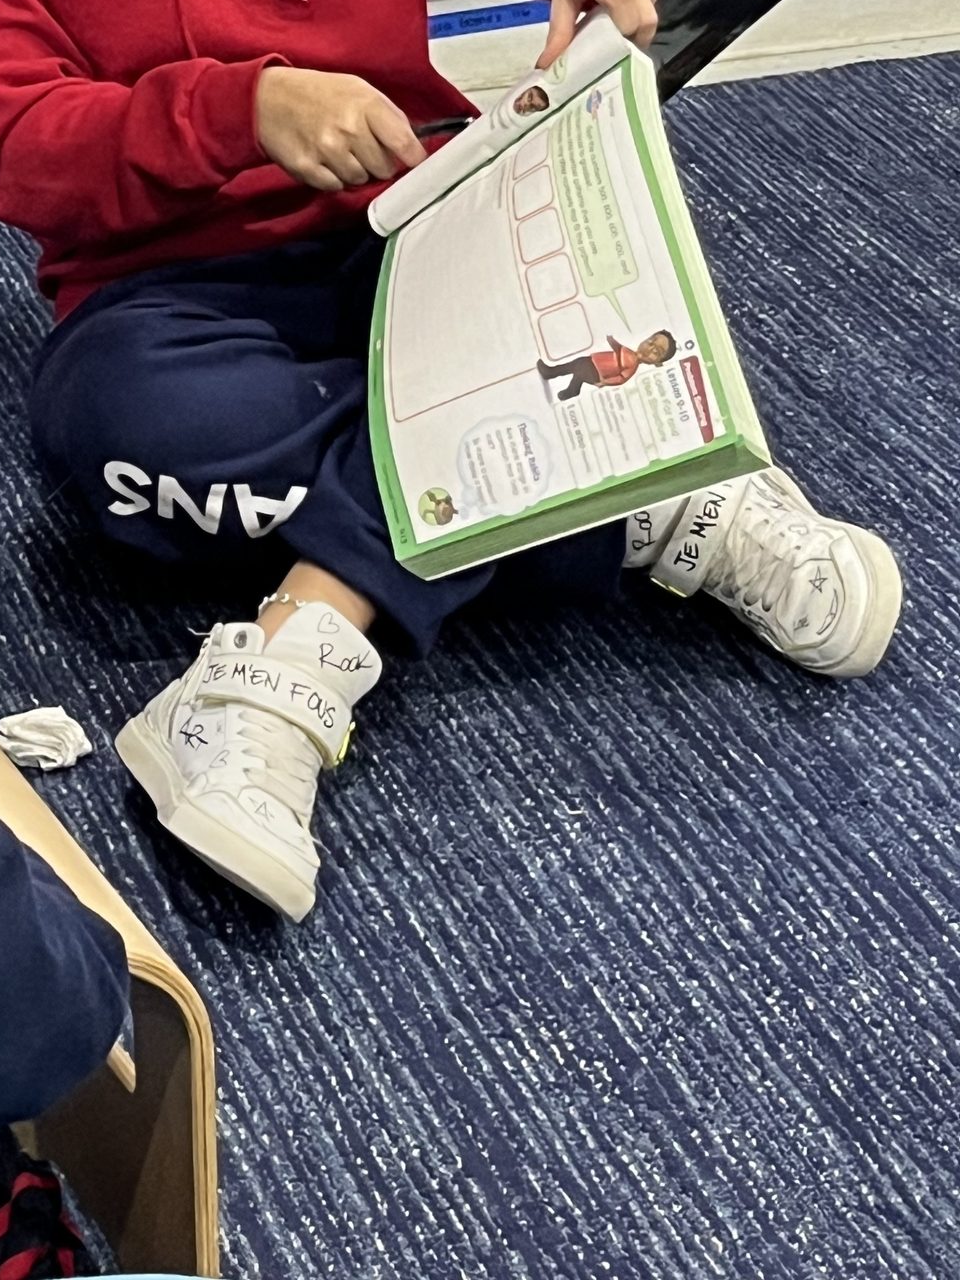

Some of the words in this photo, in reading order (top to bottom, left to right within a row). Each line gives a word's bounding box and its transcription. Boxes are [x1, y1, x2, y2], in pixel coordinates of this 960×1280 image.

[103, 460, 307, 538] ANS
[674, 542, 699, 571] JE
[203, 662, 228, 684] JE
[231, 662, 280, 693] M'EN
